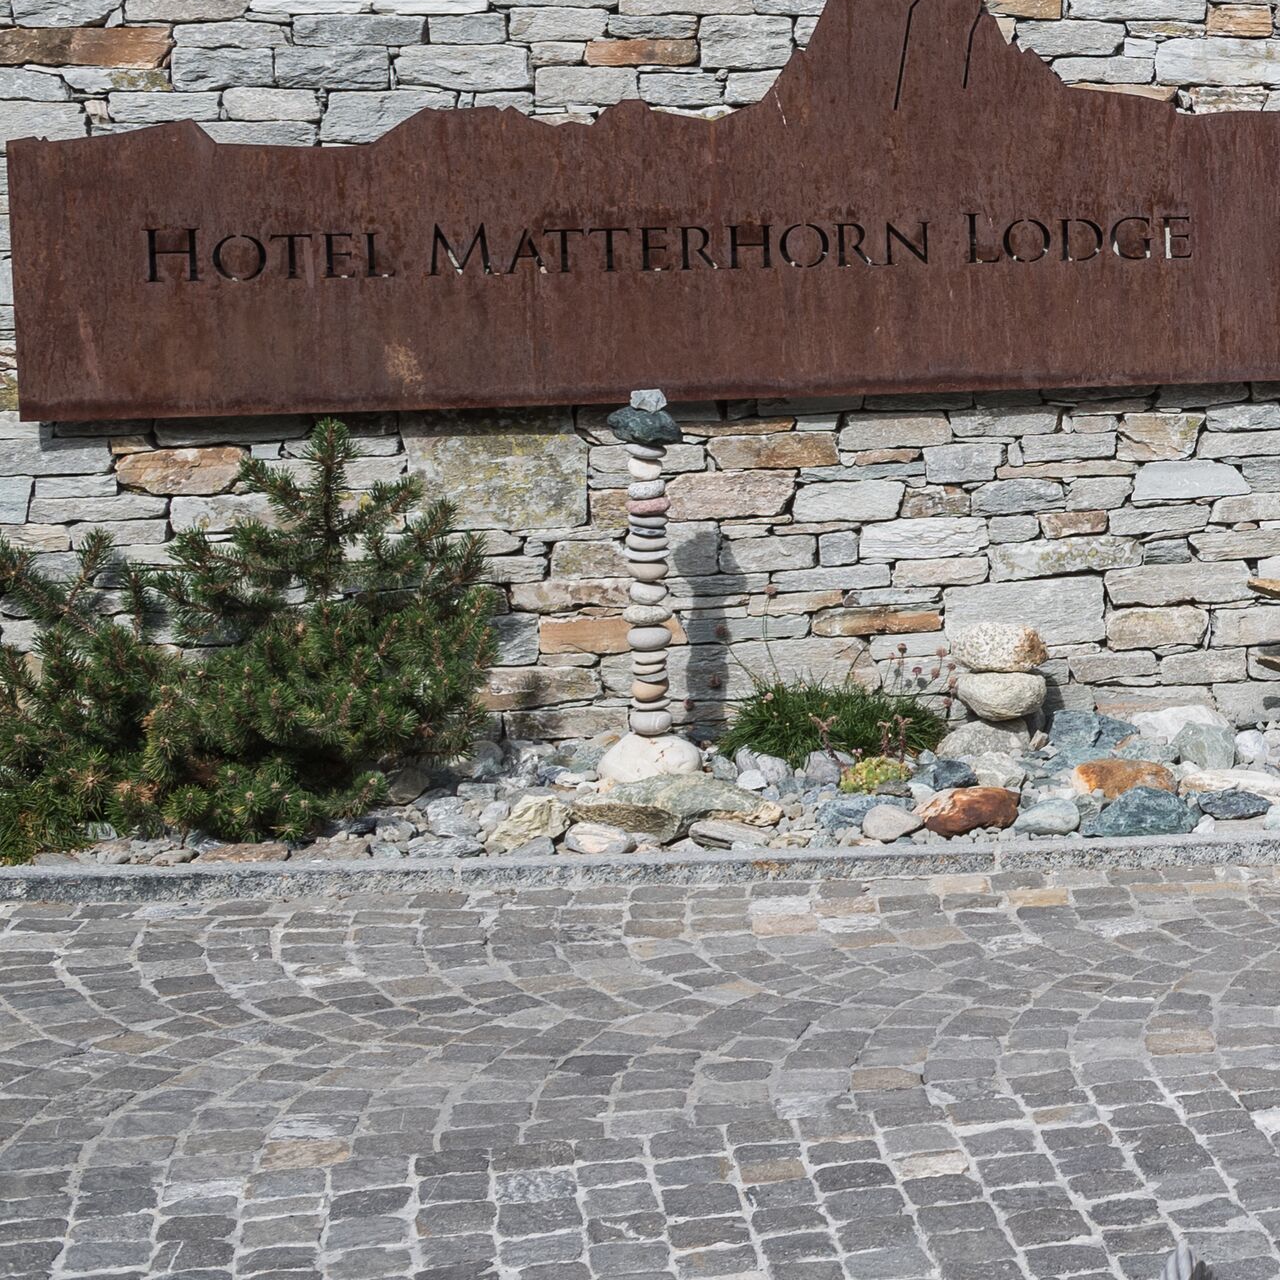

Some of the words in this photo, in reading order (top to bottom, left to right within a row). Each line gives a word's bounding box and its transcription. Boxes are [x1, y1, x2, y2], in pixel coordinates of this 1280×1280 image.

[142, 228, 397, 282] HOTEL
[425, 222, 930, 276] MATTERHORN
[963, 213, 1192, 263] LODGE
